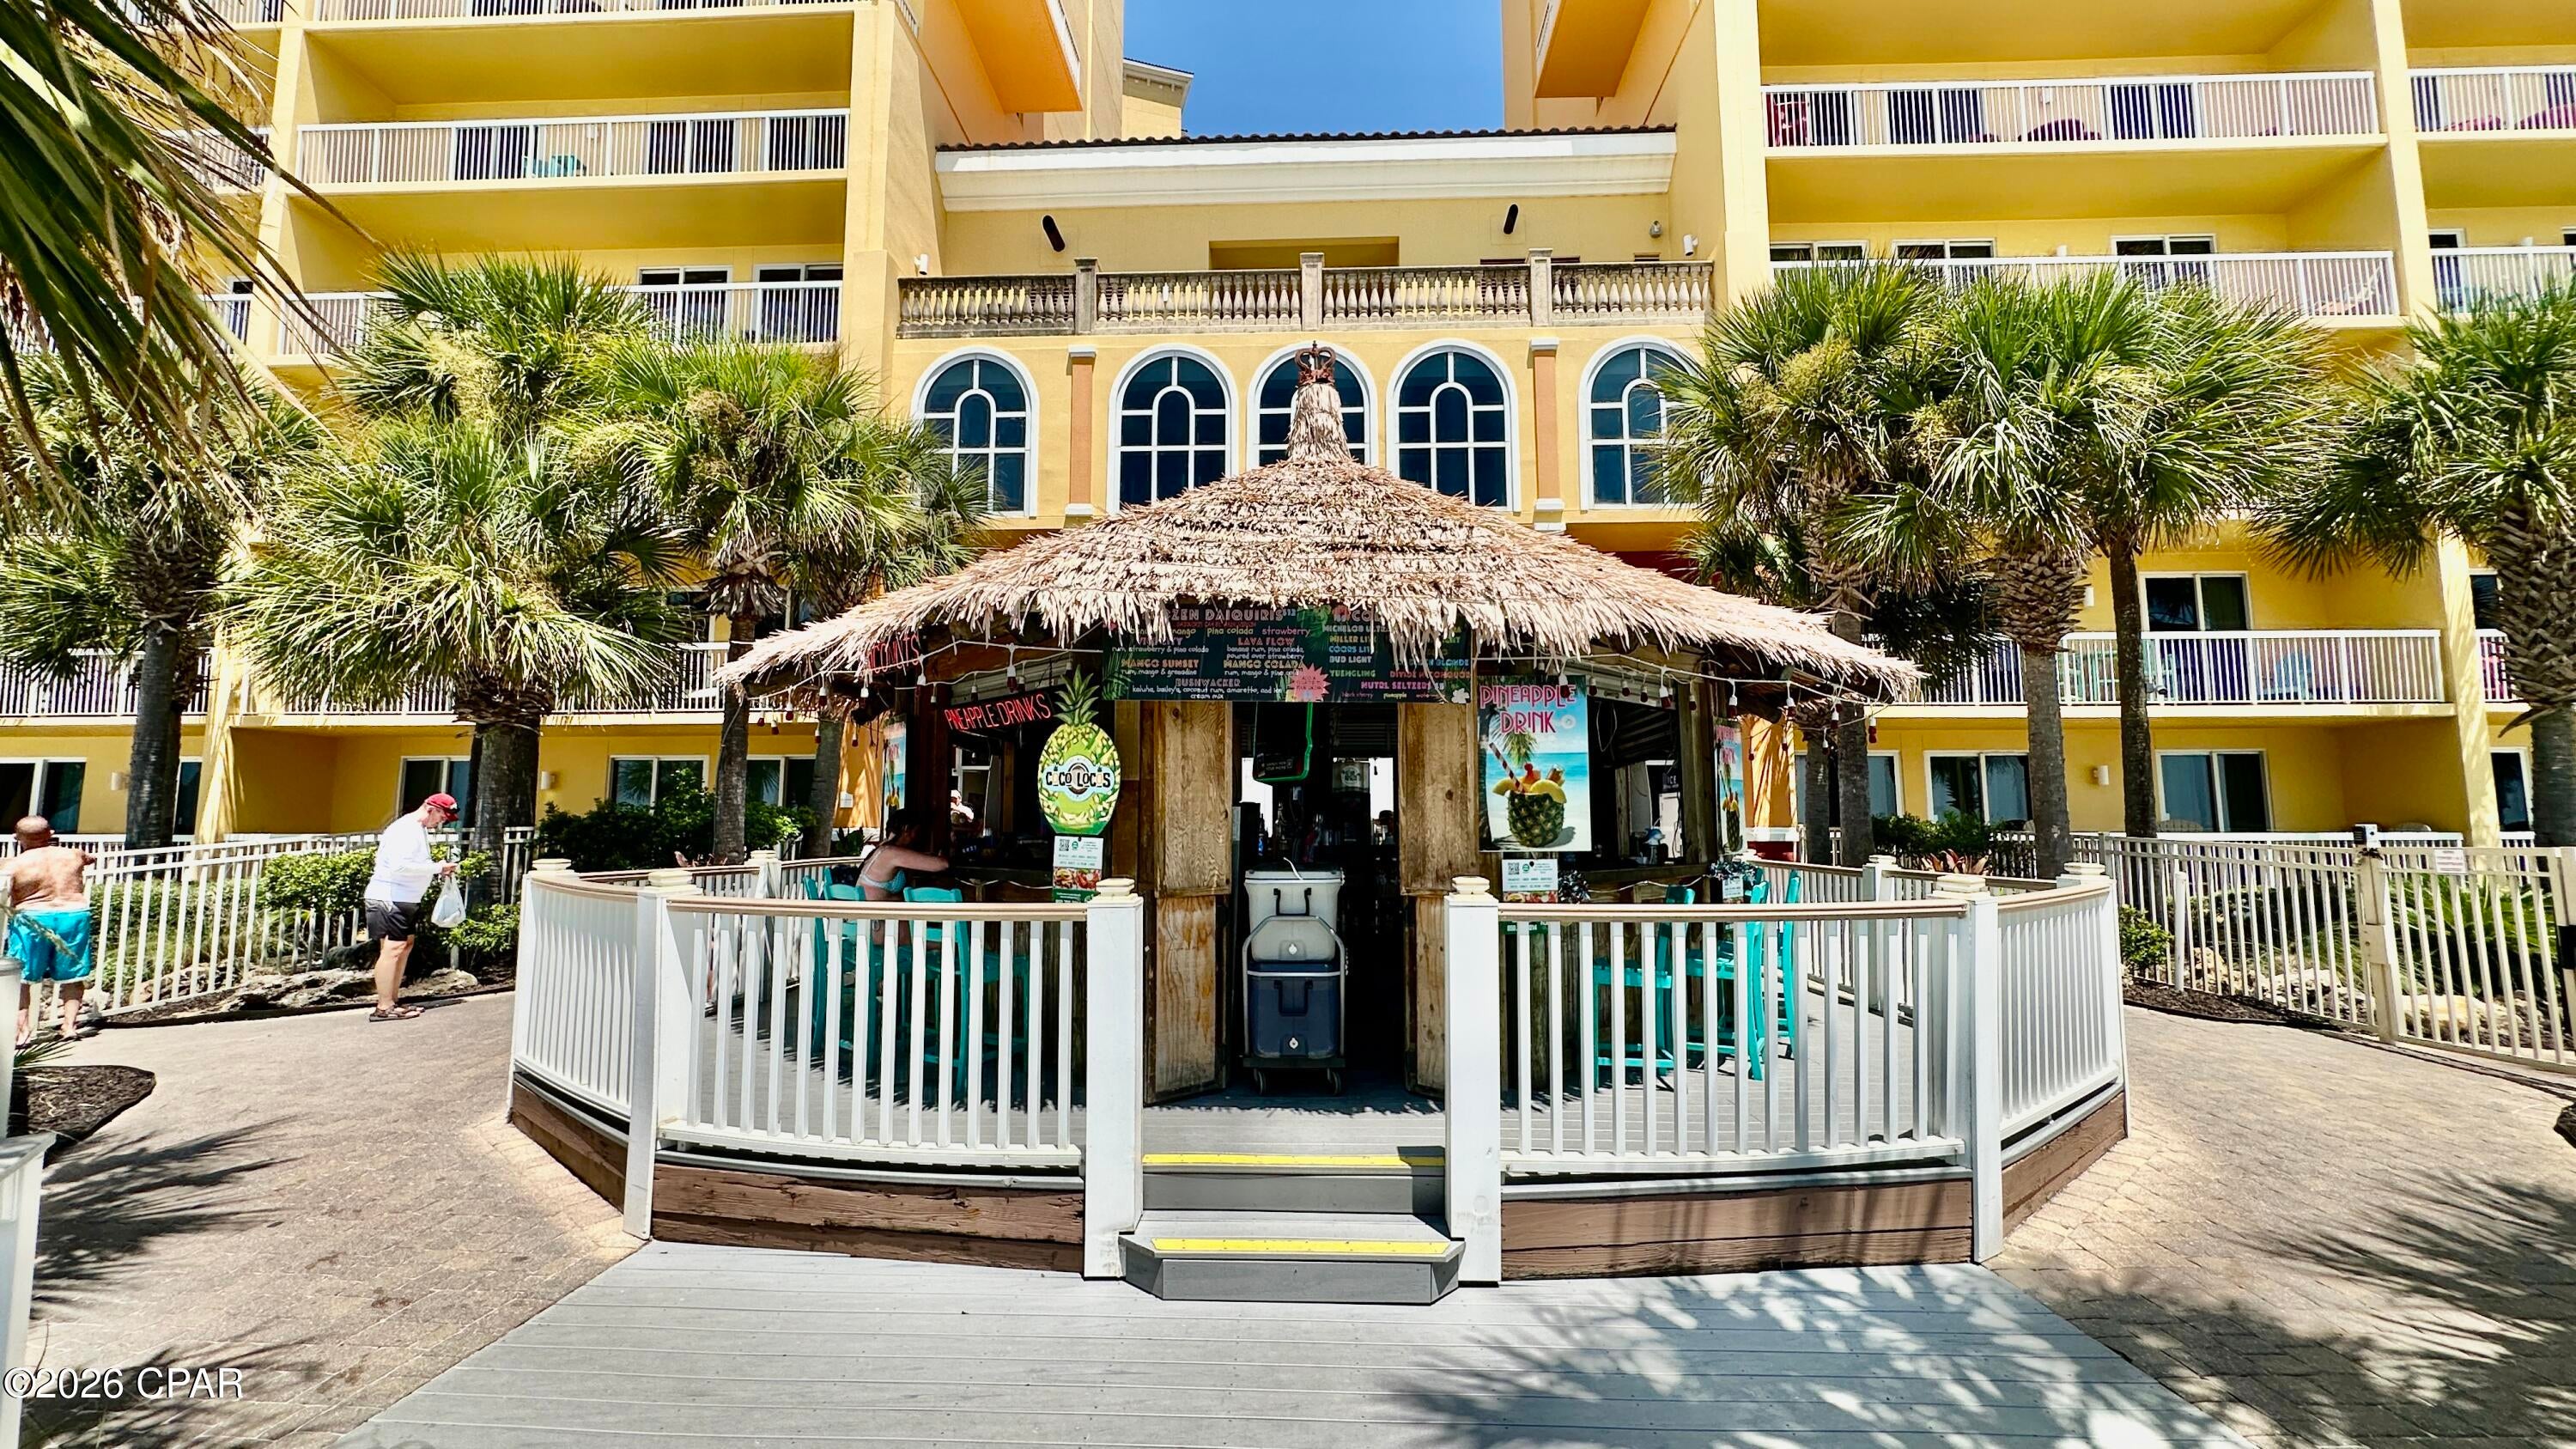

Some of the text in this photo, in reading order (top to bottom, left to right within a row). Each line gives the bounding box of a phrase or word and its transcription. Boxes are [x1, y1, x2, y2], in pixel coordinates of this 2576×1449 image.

[1205, 608, 1284, 621] DAIQUIRIS
[1226, 626, 1254, 636] colada
[1261, 625, 1310, 637] strawberry
[1322, 624, 1364, 633] MICHELOB
[1237, 637, 1295, 646] LAVA FLOW
[1329, 635, 1358, 643] MILLER
[1128, 645, 1165, 654] strawberry
[1328, 645, 1357, 654] COORS
[1267, 653, 1304, 661] strawberry
[1348, 655, 1372, 664] LIGHT
[1121, 659, 1200, 668] MANGO SUNSET
[1223, 660, 1306, 669] MANGO COLADA
[1138, 669, 1158, 678] mango
[1167, 668, 1197, 678] grenadine
[1329, 669, 1376, 679] YUENGLING
[1175, 679, 1241, 687] BUSHWACKER
[1360, 680, 1389, 690] NUTRL
[1226, 686, 1259, 695] amaretto,
[1479, 685, 1577, 709] PINEAPPLE
[944, 692, 1053, 732] PINEAPPLE DRINKS
[1500, 710, 1556, 734] DRINK
